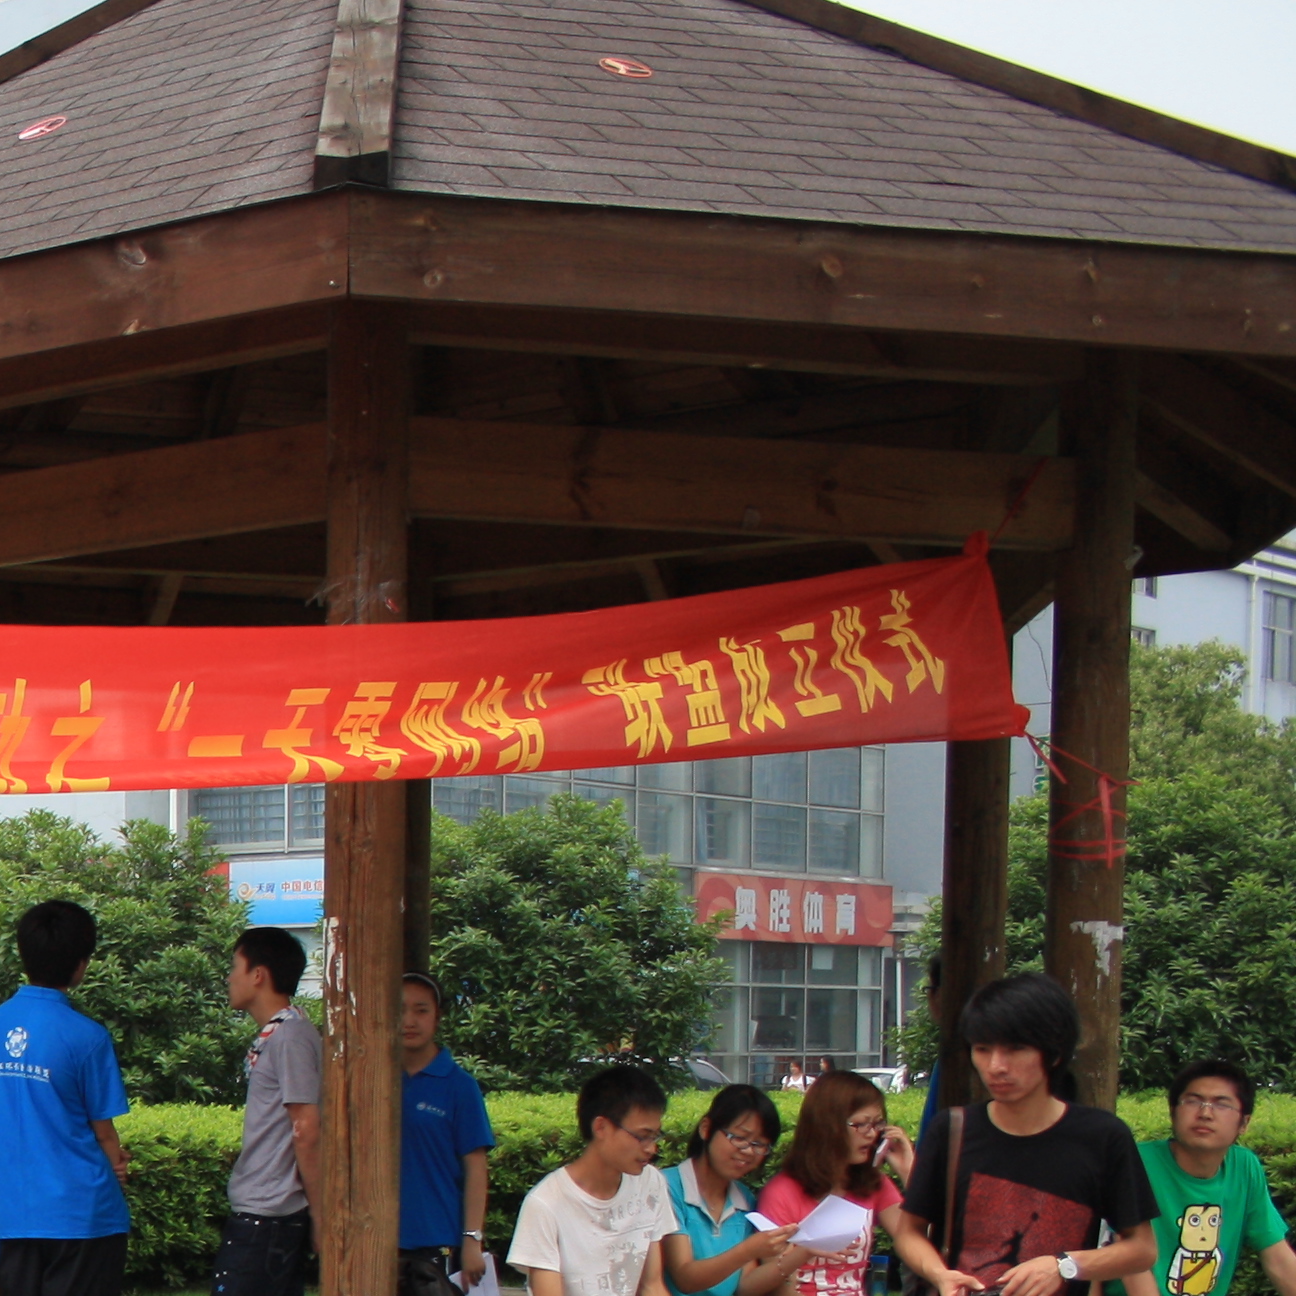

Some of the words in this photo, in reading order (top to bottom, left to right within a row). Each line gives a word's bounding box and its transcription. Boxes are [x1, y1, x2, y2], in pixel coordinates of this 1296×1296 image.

[281, 880, 324, 893] 中国电信
[734, 886, 856, 936] 奥胜体育
